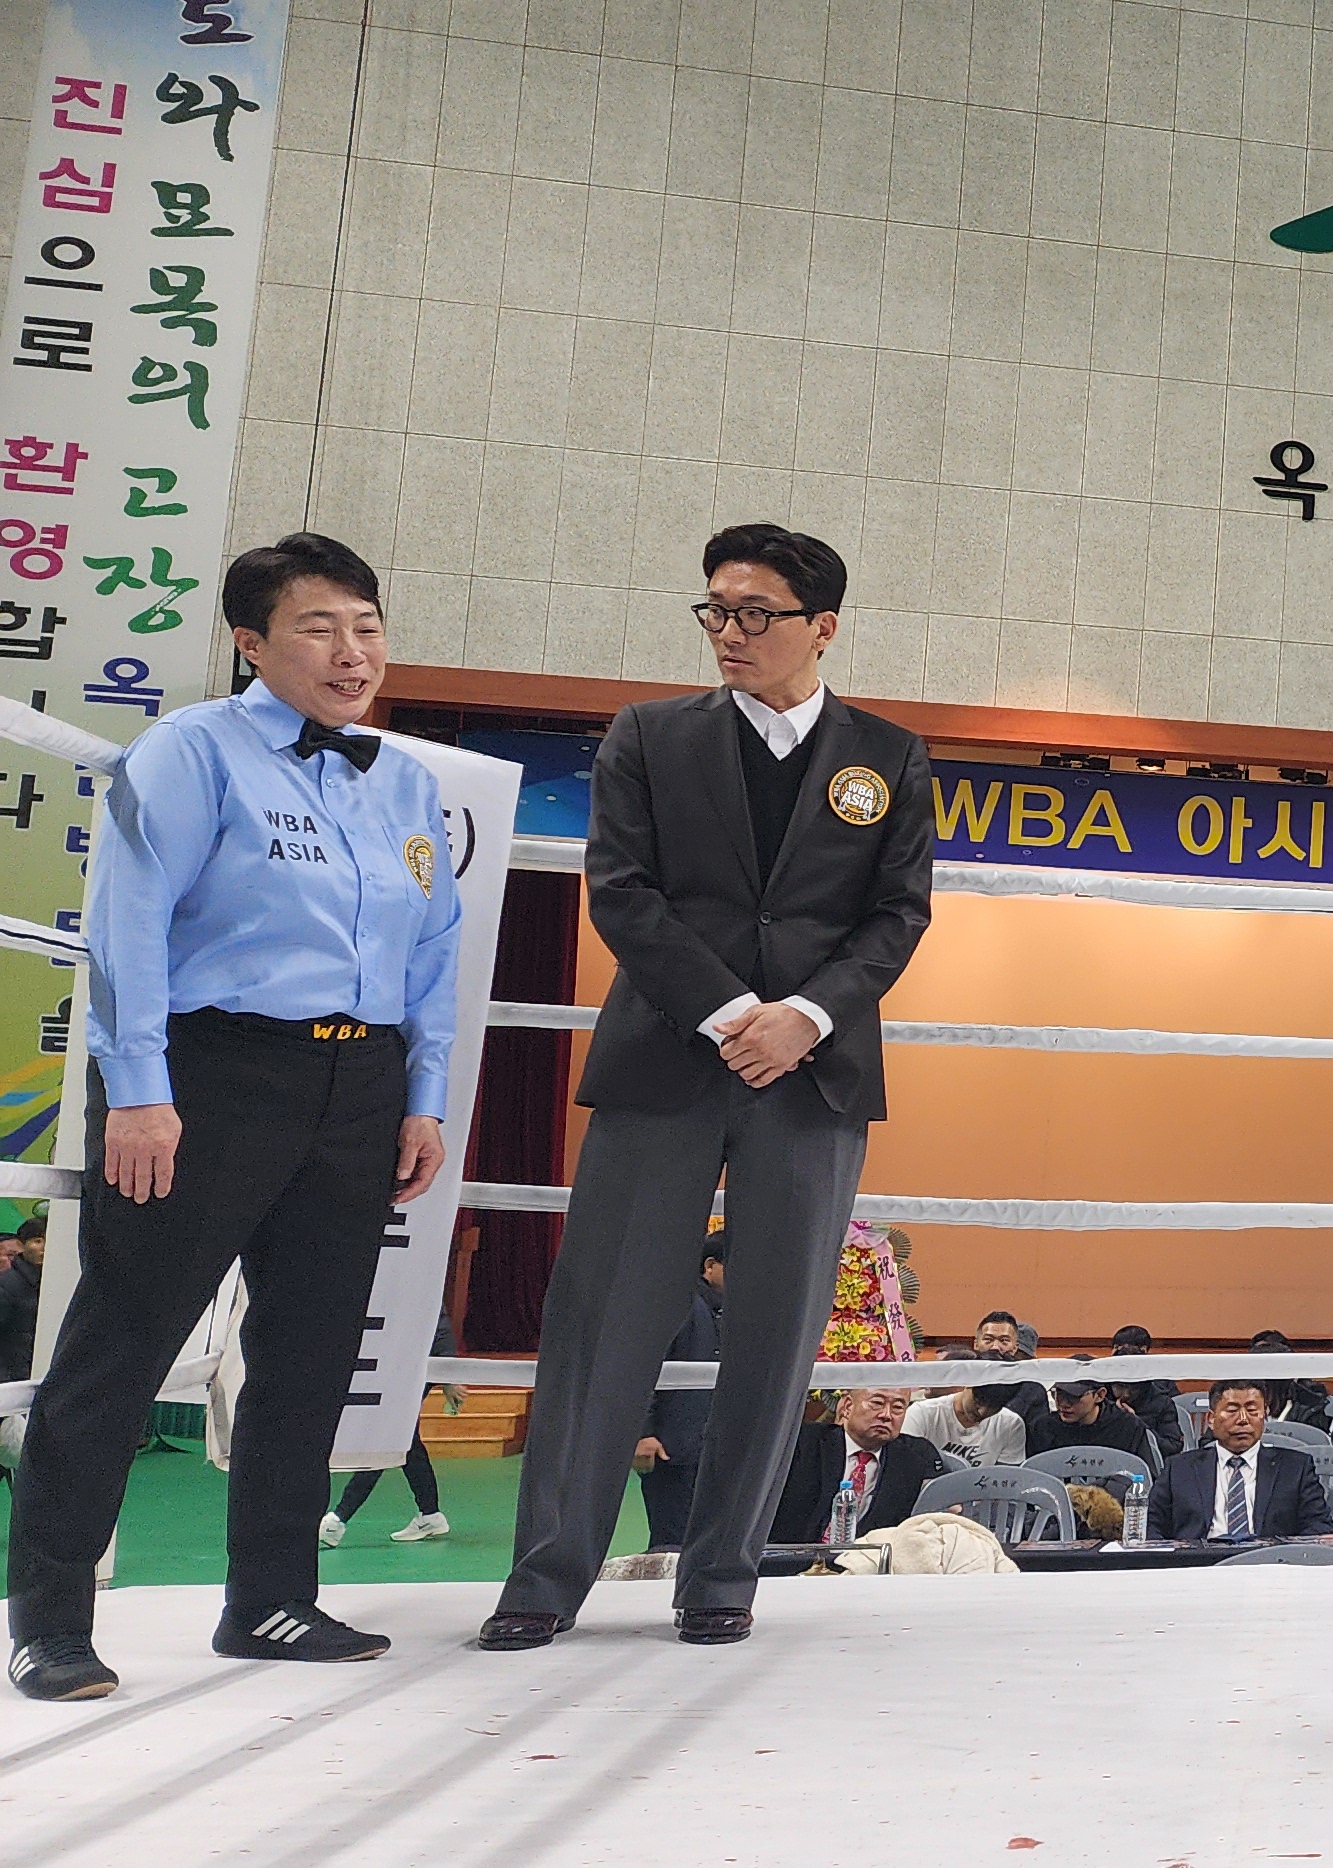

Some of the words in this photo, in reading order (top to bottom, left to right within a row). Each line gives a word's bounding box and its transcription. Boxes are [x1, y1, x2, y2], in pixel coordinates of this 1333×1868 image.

[13, 76, 128, 373] 진심으로
[128, 180, 235, 430] 묘목의
[83, 466, 199, 634] 고장
[841, 790, 873, 812] ASIA
[848, 781, 874, 799] WBA
[262, 809, 319, 835] WBA
[931, 776, 1132, 853] WBA
[268, 838, 329, 865] ASIA
[313, 1023, 368, 1041] WBA
[941, 1442, 980, 1461] NIKE
